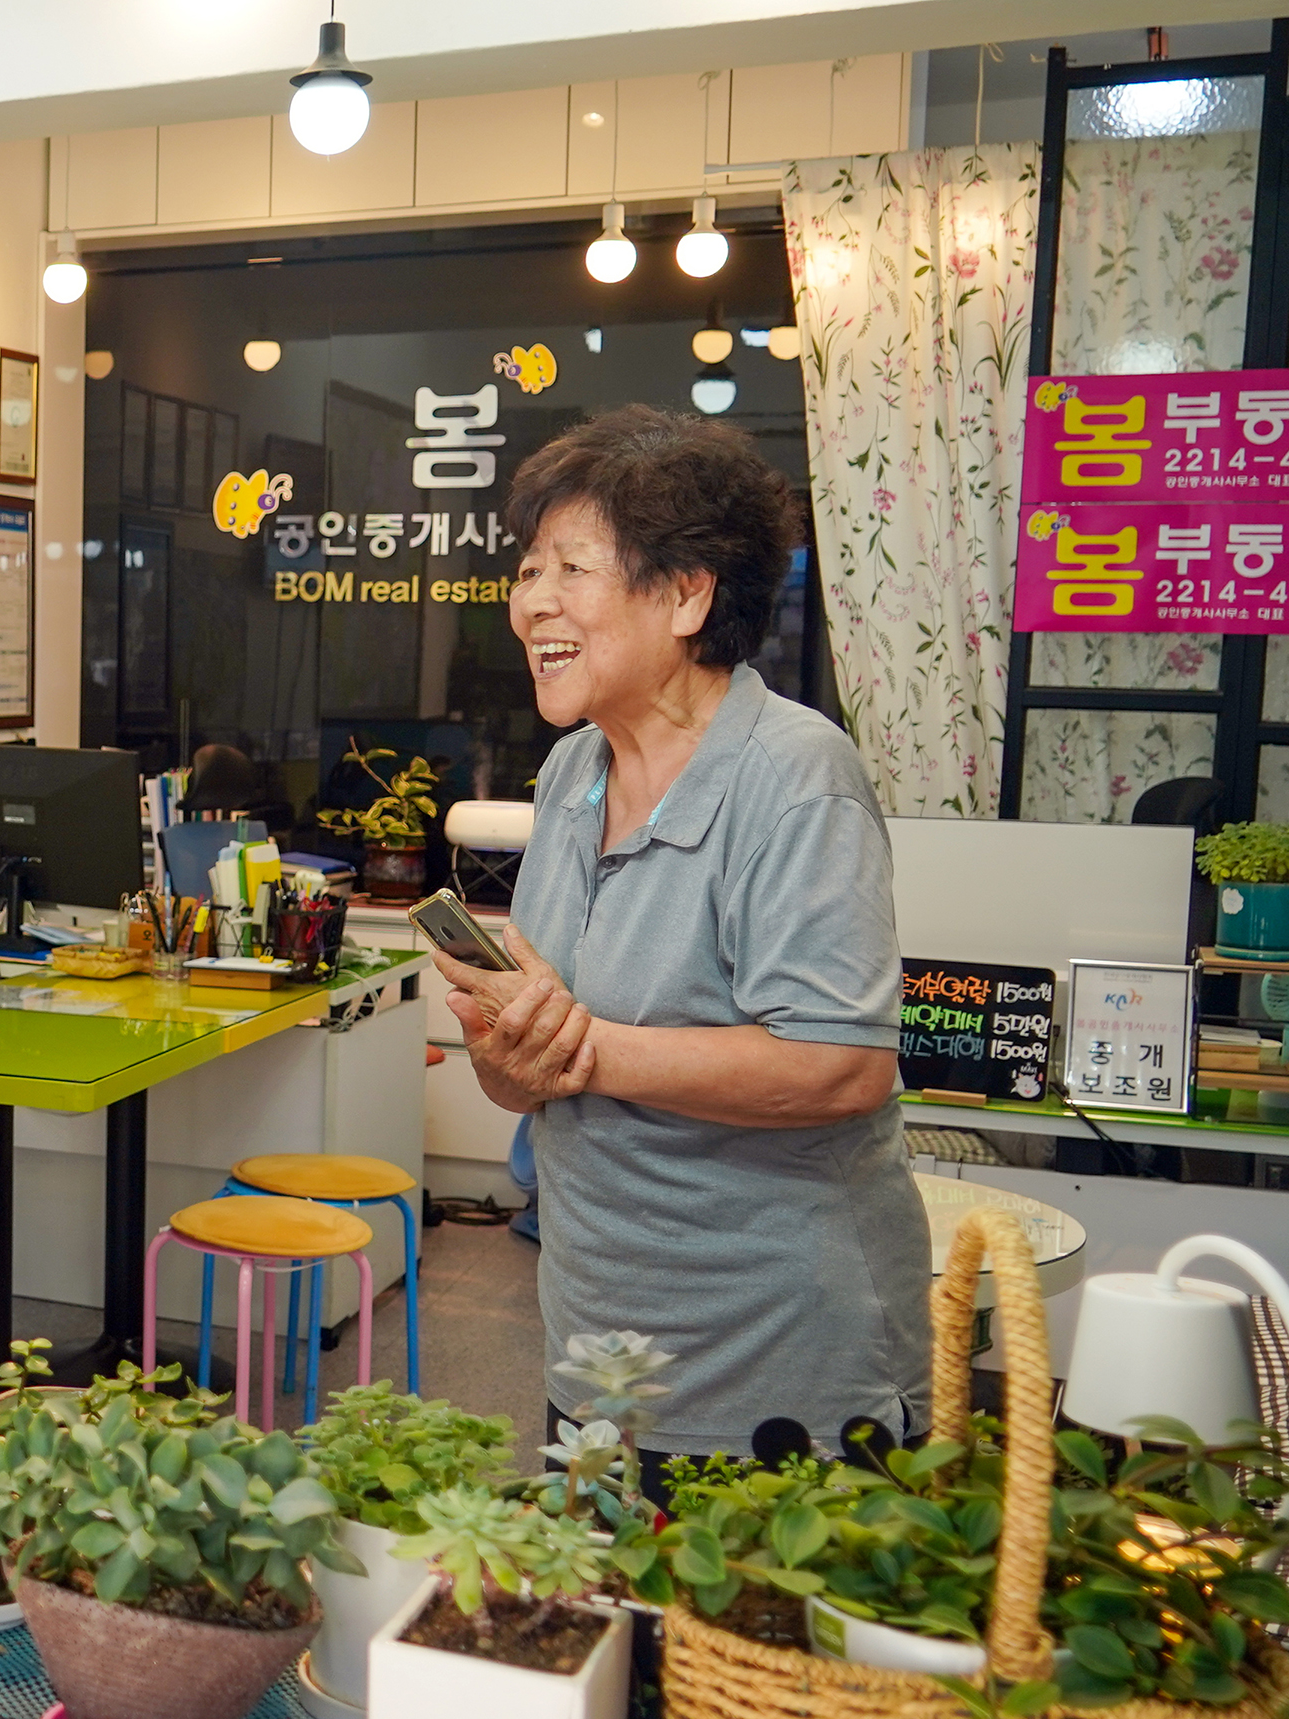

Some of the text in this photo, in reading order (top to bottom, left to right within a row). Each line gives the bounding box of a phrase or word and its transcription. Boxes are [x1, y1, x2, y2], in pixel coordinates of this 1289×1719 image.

[405, 383, 506, 489] 봄
[1054, 395, 1152, 486] 봄
[1165, 475, 1260, 488] 공인중개사사무소
[273, 511, 516, 558] 공인중개사
[1046, 523, 1284, 616] 봄 부동
[274, 570, 355, 603] BOM
[359, 574, 420, 603] real
[1155, 579, 1288, 604] 2214-4
[1157, 606, 1285, 620] 공인중개사사무소 대표
[996, 981, 1053, 1003] 1500원
[993, 1012, 1051, 1039] 5만원
[990, 1039, 1048, 1063] 1500원
[1078, 1073, 1172, 1101] 보조원
